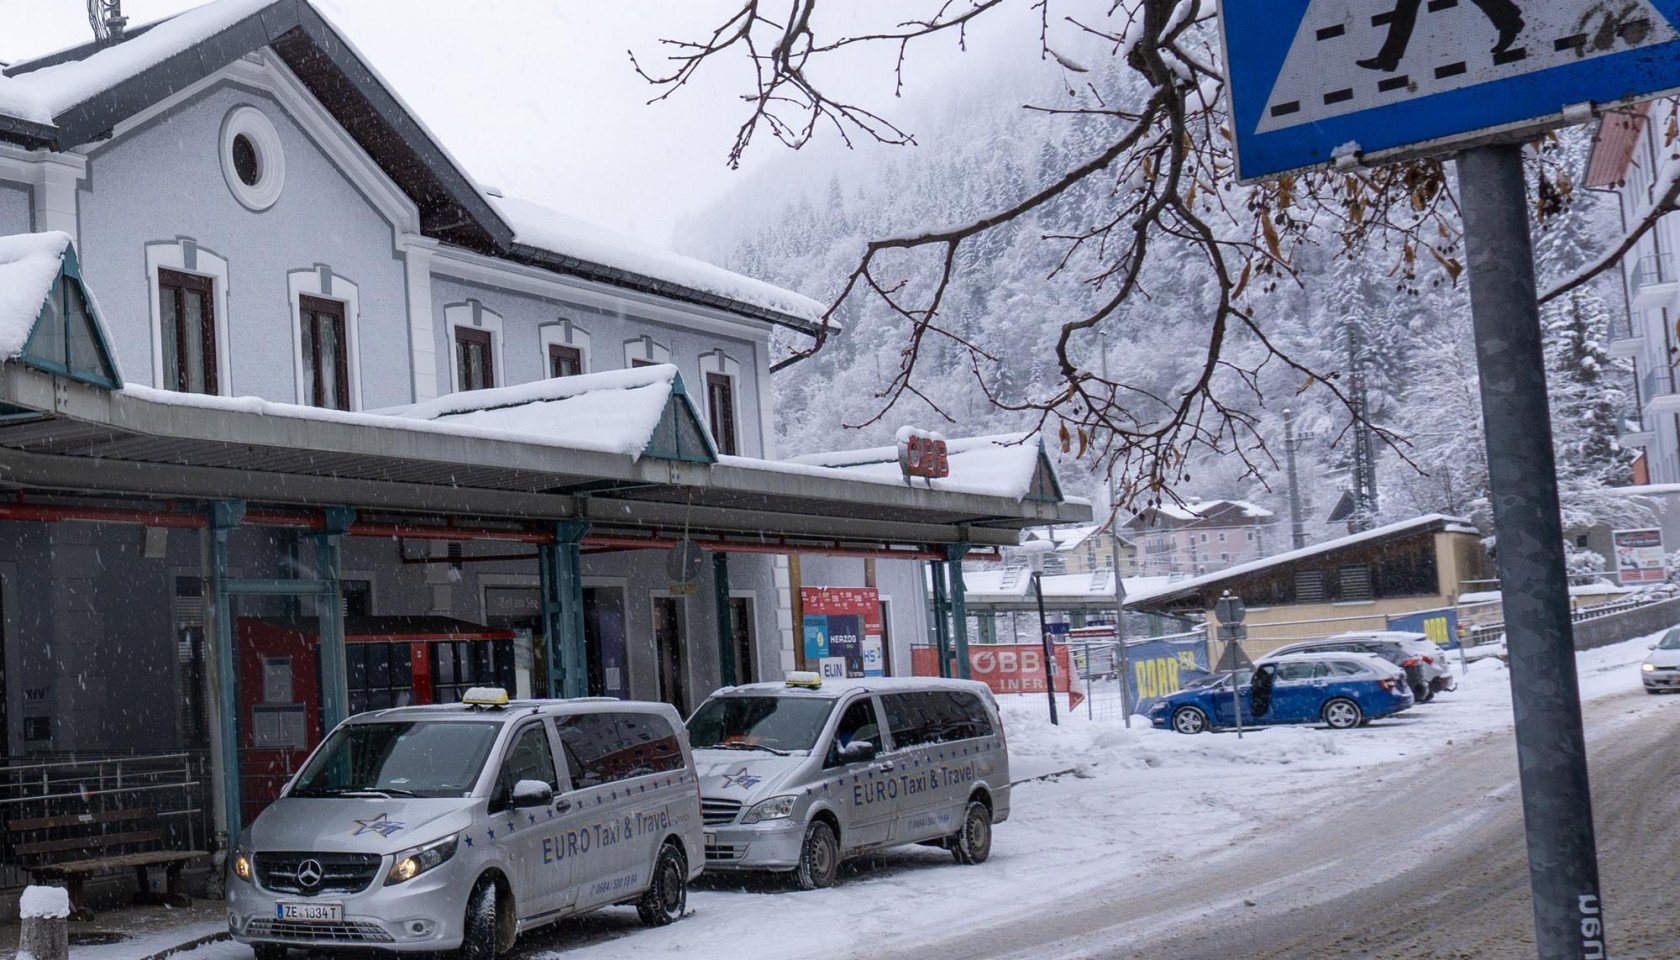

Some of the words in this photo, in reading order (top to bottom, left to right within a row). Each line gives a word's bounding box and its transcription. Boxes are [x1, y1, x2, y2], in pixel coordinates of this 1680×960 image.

[906, 435, 949, 477] ÖBB
[829, 634, 857, 644] HERZOG
[972, 650, 1040, 674] ÖBB
[853, 778, 898, 807] EURO
[901, 771, 926, 796] Taxi
[929, 769, 939, 790] &
[940, 760, 976, 787] Travel
[542, 827, 591, 865] EURO
[593, 821, 620, 849] Taxi
[624, 816, 632, 841] &
[635, 804, 672, 836] Travel
[285, 906, 298, 918] ZE
